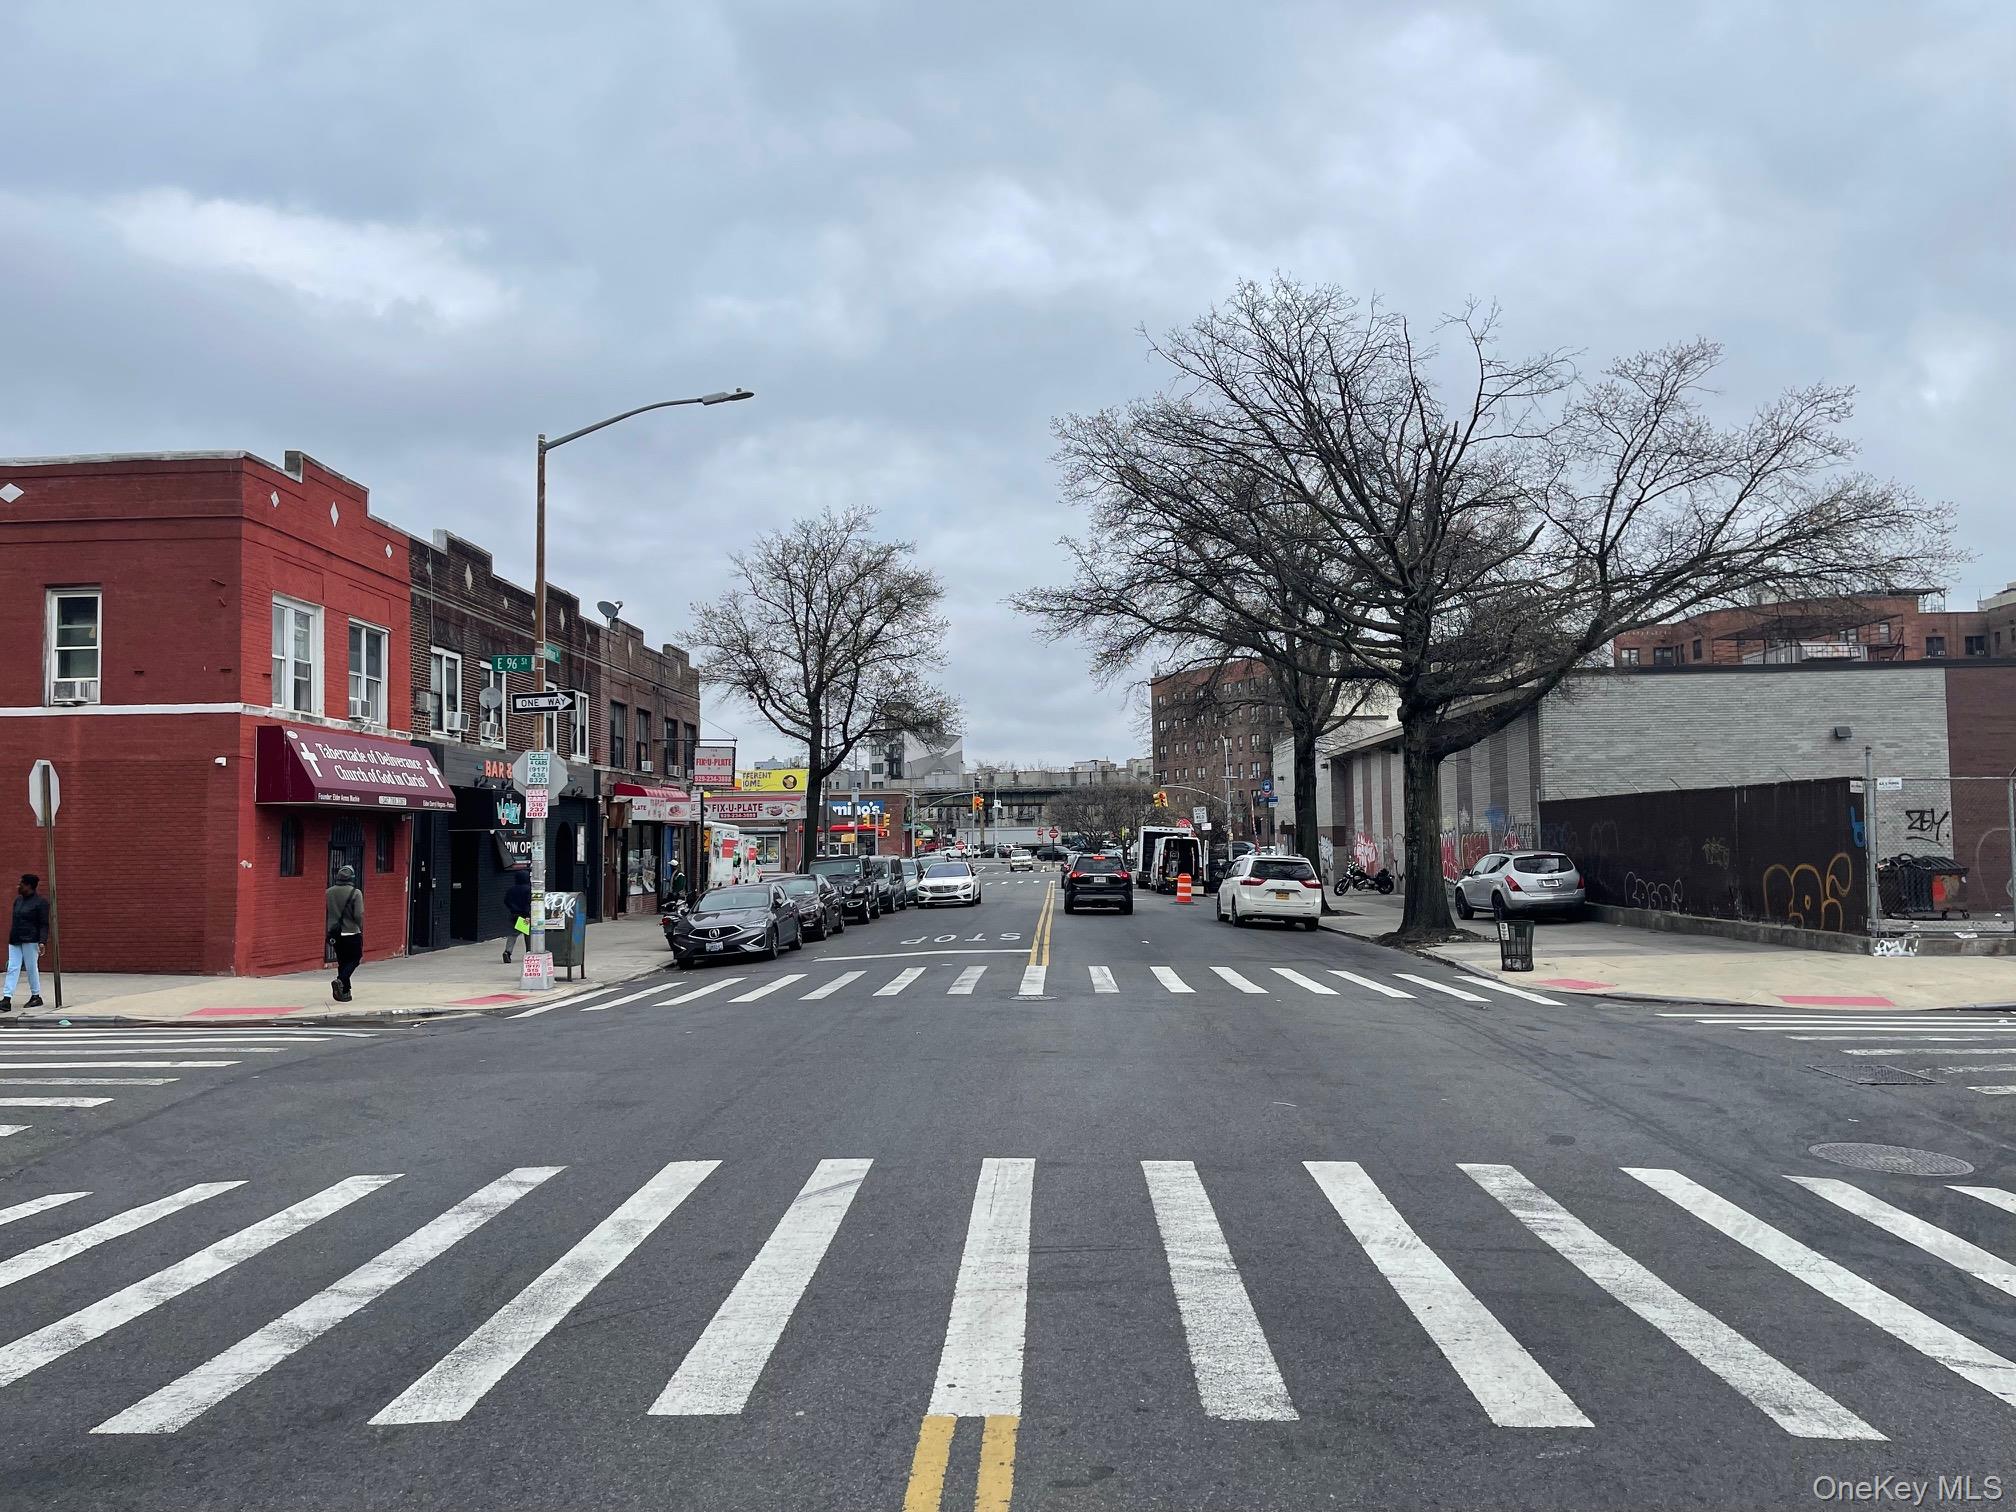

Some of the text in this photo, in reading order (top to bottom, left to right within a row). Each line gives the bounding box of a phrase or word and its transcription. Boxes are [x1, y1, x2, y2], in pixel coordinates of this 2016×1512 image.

[497, 658, 503, 669] E
[507, 658, 517, 670] 96
[521, 697, 566, 707] ONE WAY
[315, 742, 424, 770] Tabernacle of Deliverance
[485, 760, 504, 779] BAR
[334, 765, 429, 788] Church of God in Christ
[505, 841, 519, 853] OW
[900, 932, 1021, 945] STOP
